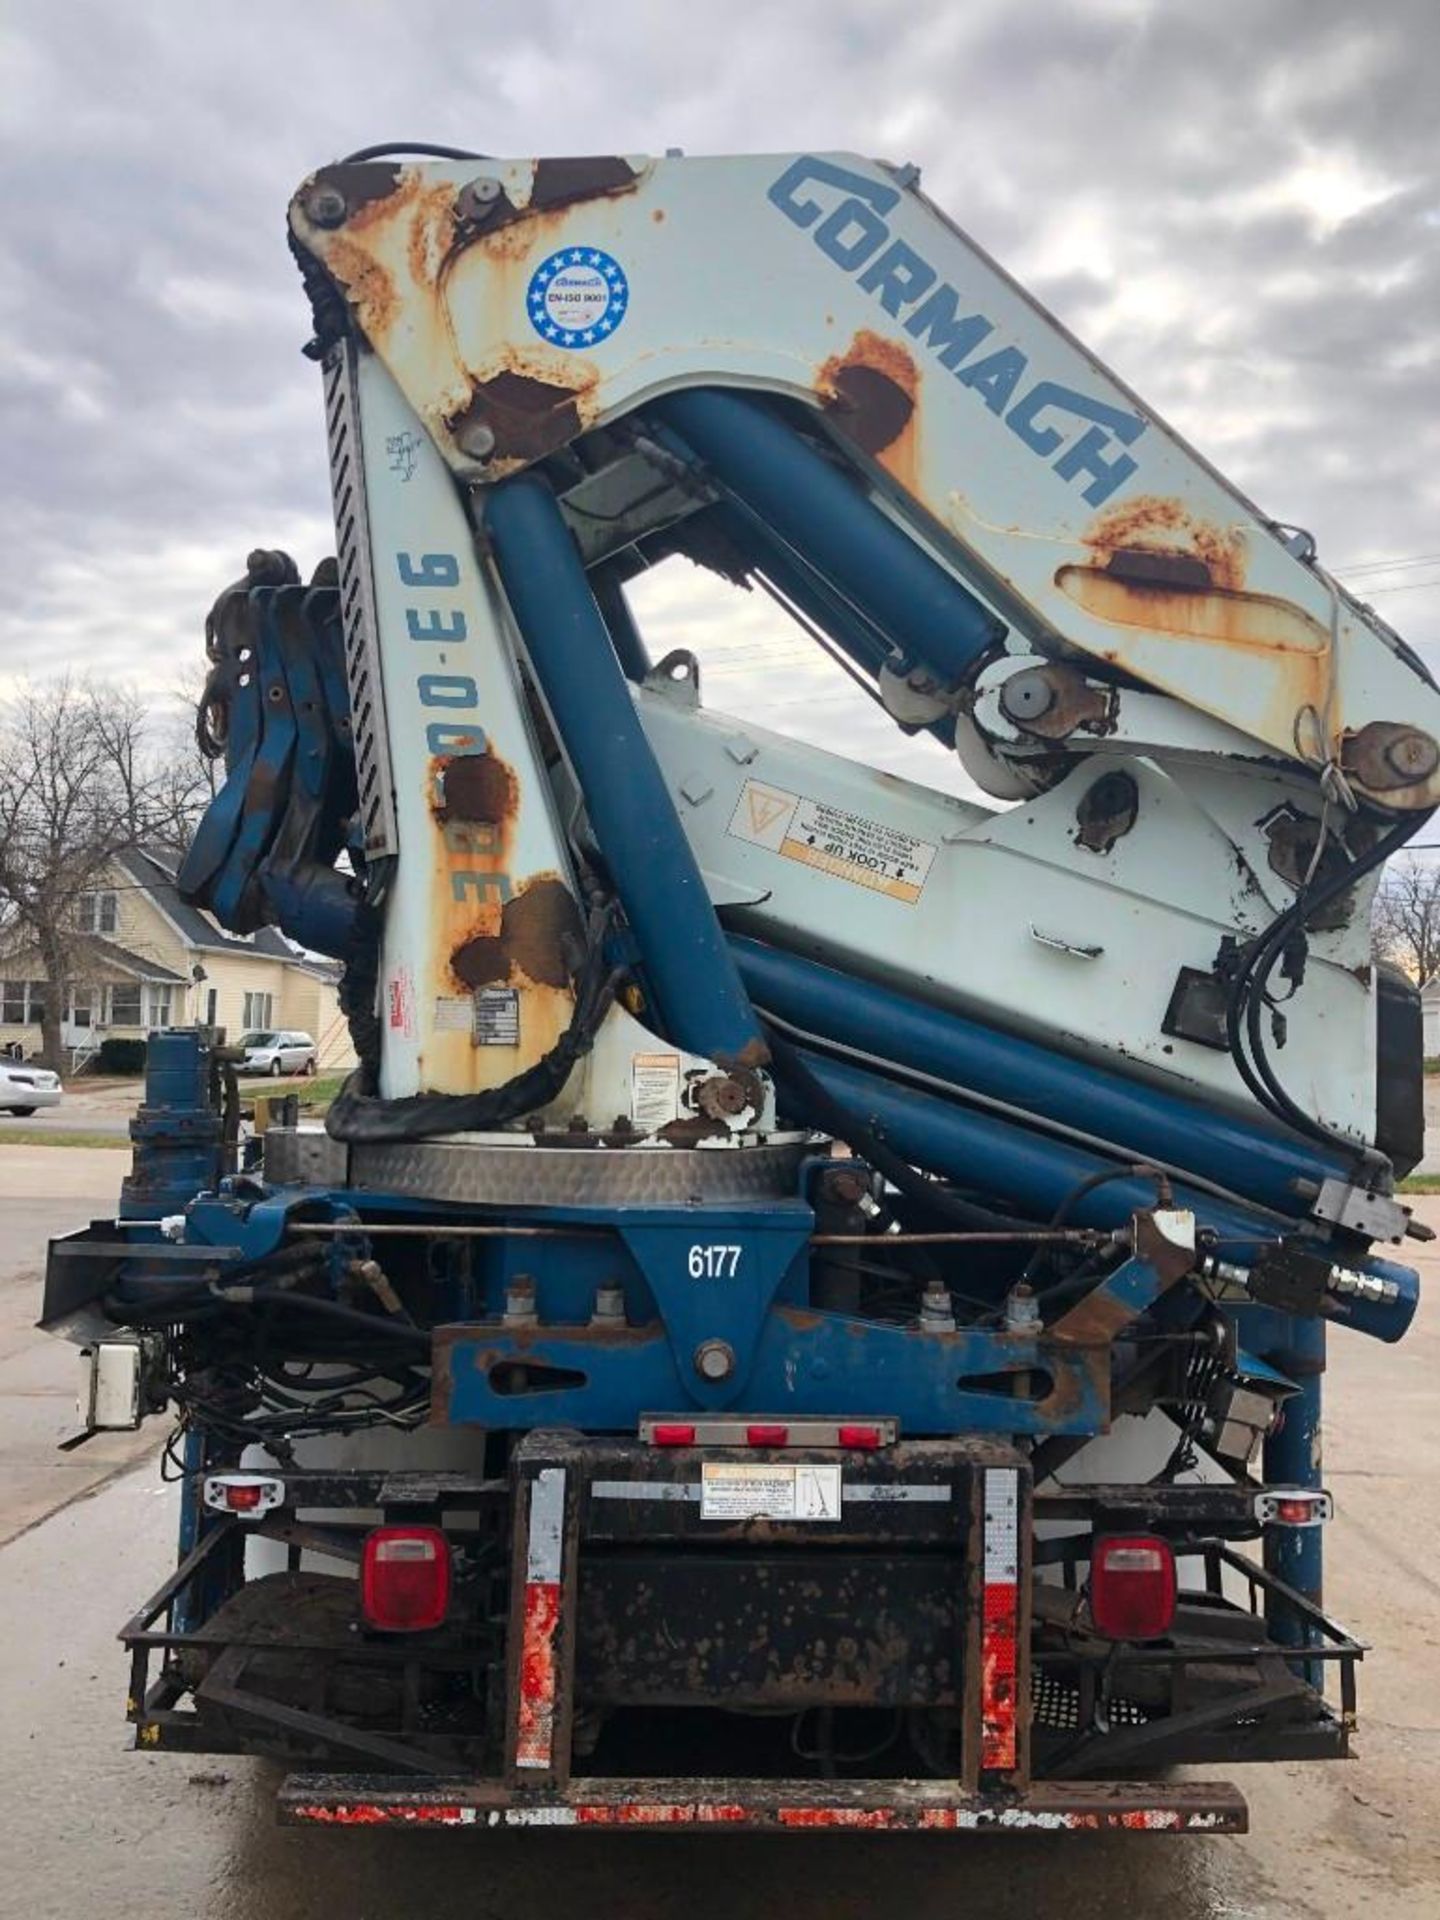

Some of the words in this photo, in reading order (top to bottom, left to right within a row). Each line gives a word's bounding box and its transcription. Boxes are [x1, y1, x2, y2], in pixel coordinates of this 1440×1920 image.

[767, 155, 1146, 508] CORMACH
[823, 843, 844, 857] UP
[849, 850, 887, 872] LOOK
[688, 1244, 742, 1278] 6177
